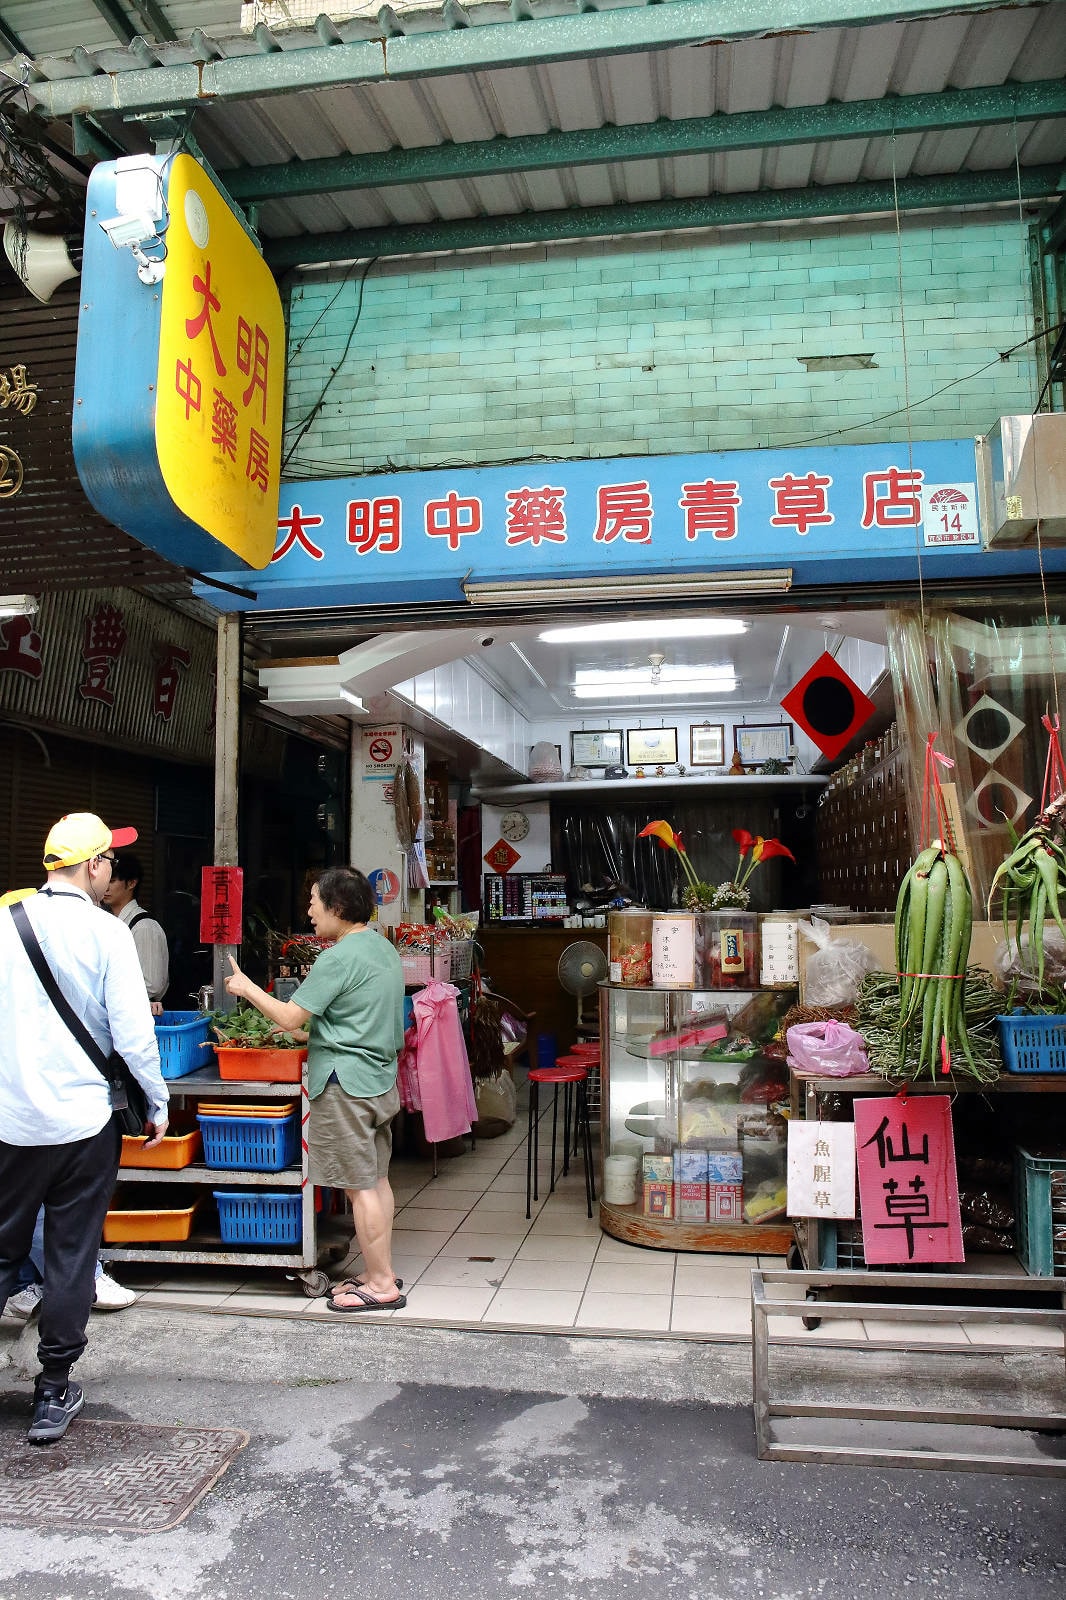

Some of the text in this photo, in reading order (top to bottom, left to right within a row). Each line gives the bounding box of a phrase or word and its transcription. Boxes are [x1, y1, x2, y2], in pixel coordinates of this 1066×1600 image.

[185, 259, 271, 426] 大明
[175, 357, 271, 495] 中藥房
[270, 466, 923, 561] 大明中藥房青草店
[941, 513, 962, 532] 14
[209, 870, 233, 944] 青草茶
[813, 1139, 832, 1209] 魚腥草
[861, 1116, 949, 1259] 仙草
